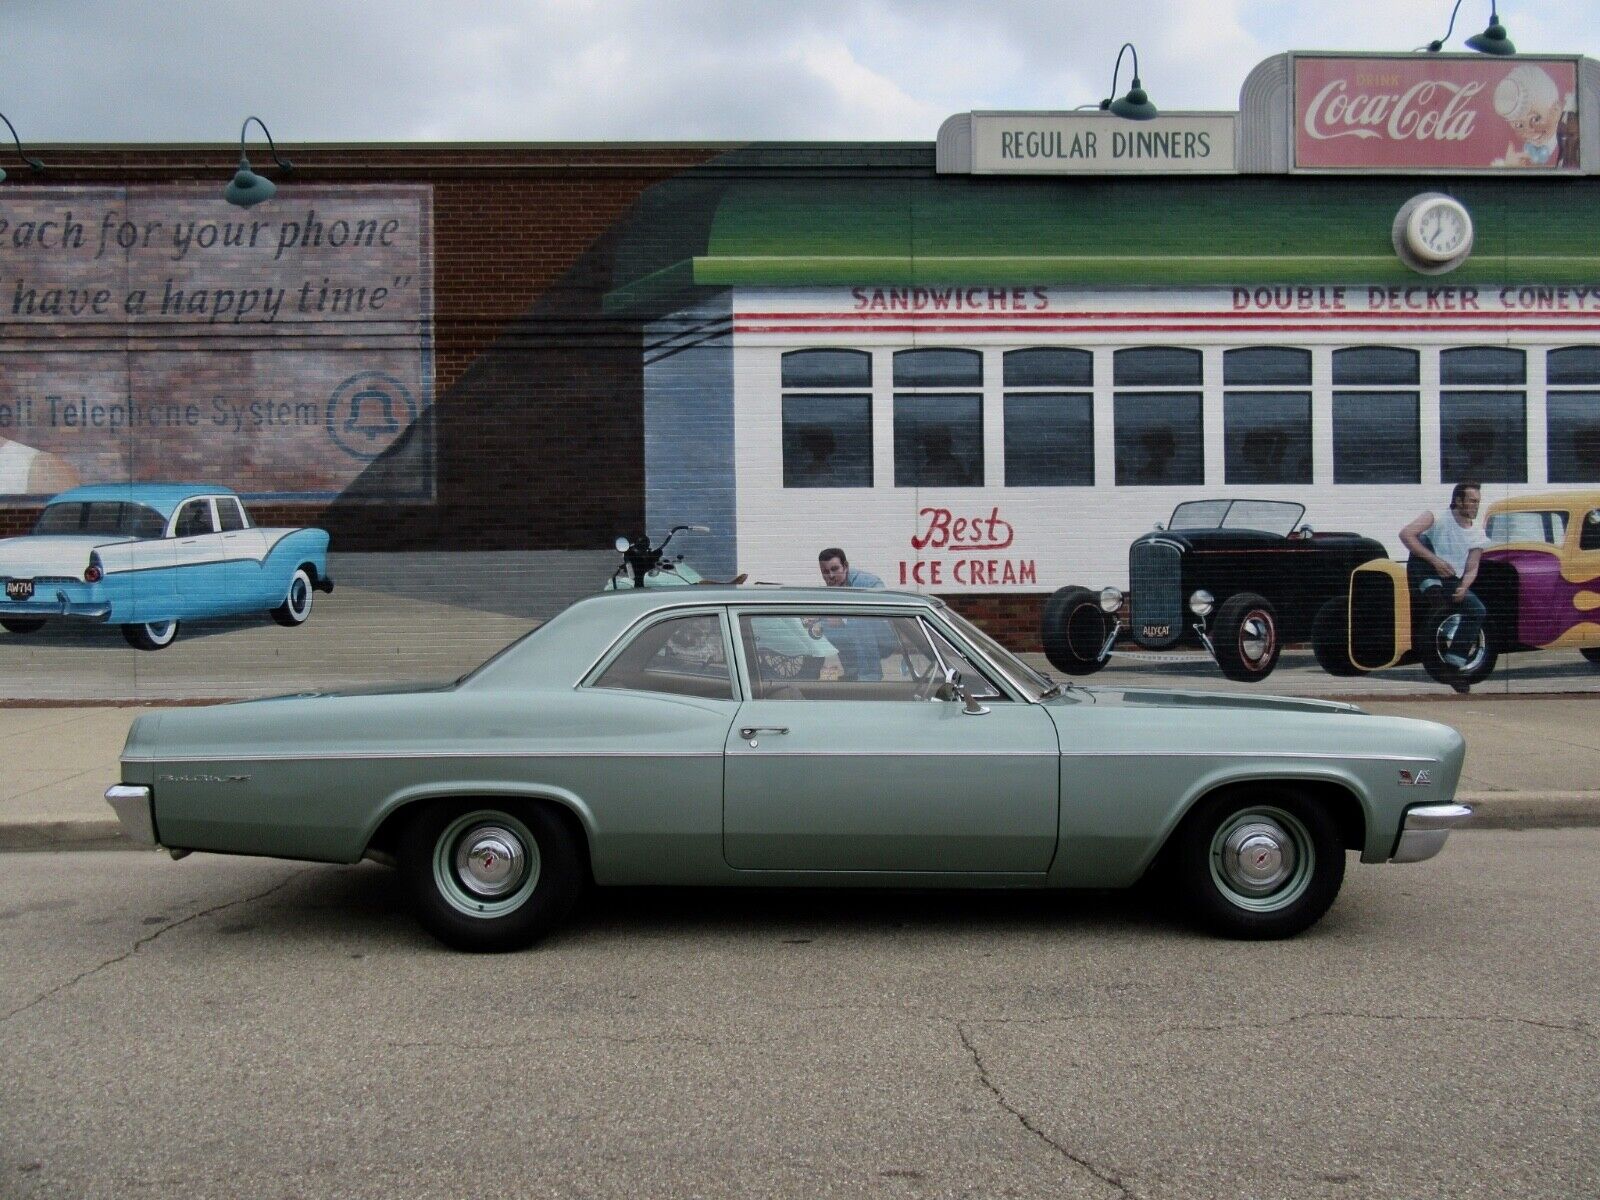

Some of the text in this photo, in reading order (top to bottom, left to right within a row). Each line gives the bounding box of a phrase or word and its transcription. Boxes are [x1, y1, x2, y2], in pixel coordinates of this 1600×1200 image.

[1357, 73, 1400, 86] DRINK
[1001, 131, 1211, 159] REGULAR DINNERS
[94, 210, 162, 259] for
[171, 220, 269, 262] your
[274, 209, 400, 260] phone
[12, 278, 112, 316] have
[124, 289, 147, 315] a
[160, 278, 285, 325] happy
[853, 286, 1050, 311] SANDWICHES
[1232, 284, 1600, 311] DOUBLE DECKER CONEYS
[45, 395, 201, 433] Telephone
[211, 395, 319, 434] System
[911, 507, 1014, 551] Best
[899, 559, 1037, 585] ICE CREAM
